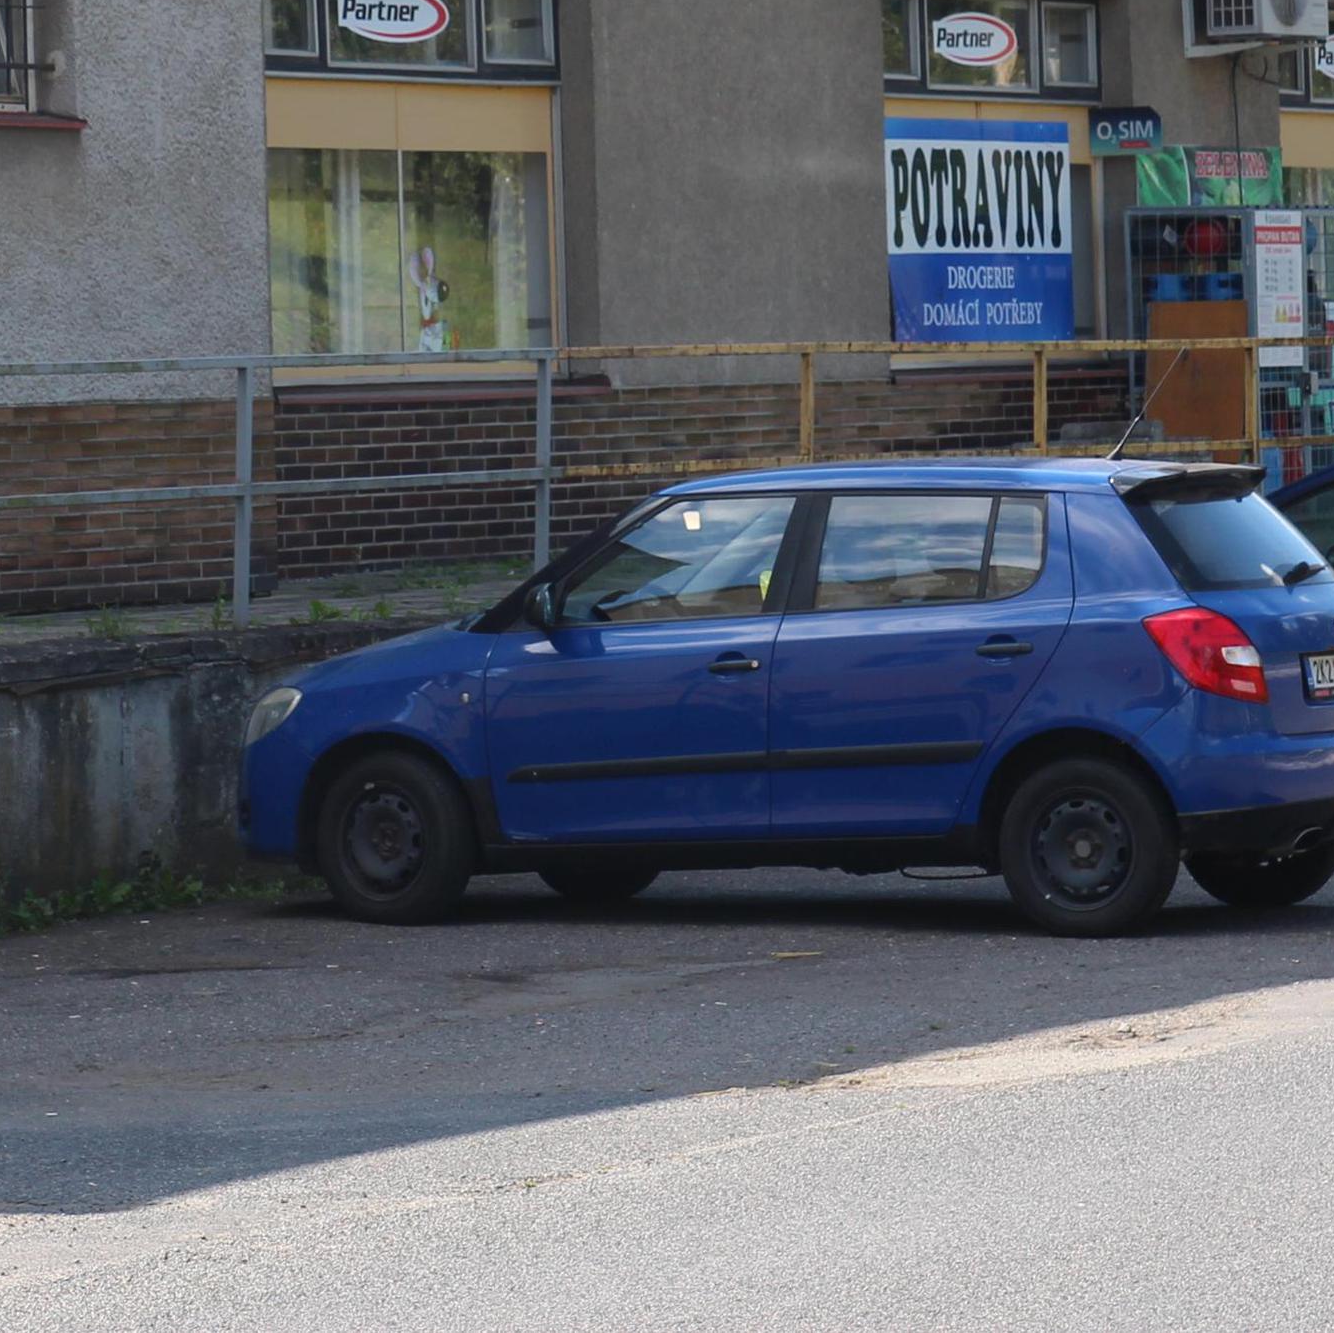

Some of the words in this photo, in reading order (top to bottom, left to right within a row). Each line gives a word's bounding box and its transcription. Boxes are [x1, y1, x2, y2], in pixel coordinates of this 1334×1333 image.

[937, 28, 994, 48] Partner
[1119, 120, 1154, 140] SIM
[891, 147, 1064, 248] POTRAVINY
[948, 266, 1016, 289] DROGERIE
[923, 299, 980, 326] DOMÁCÍ
[986, 298, 1044, 324] POTŘEBY
[1313, 660, 1334, 684] 2K2
